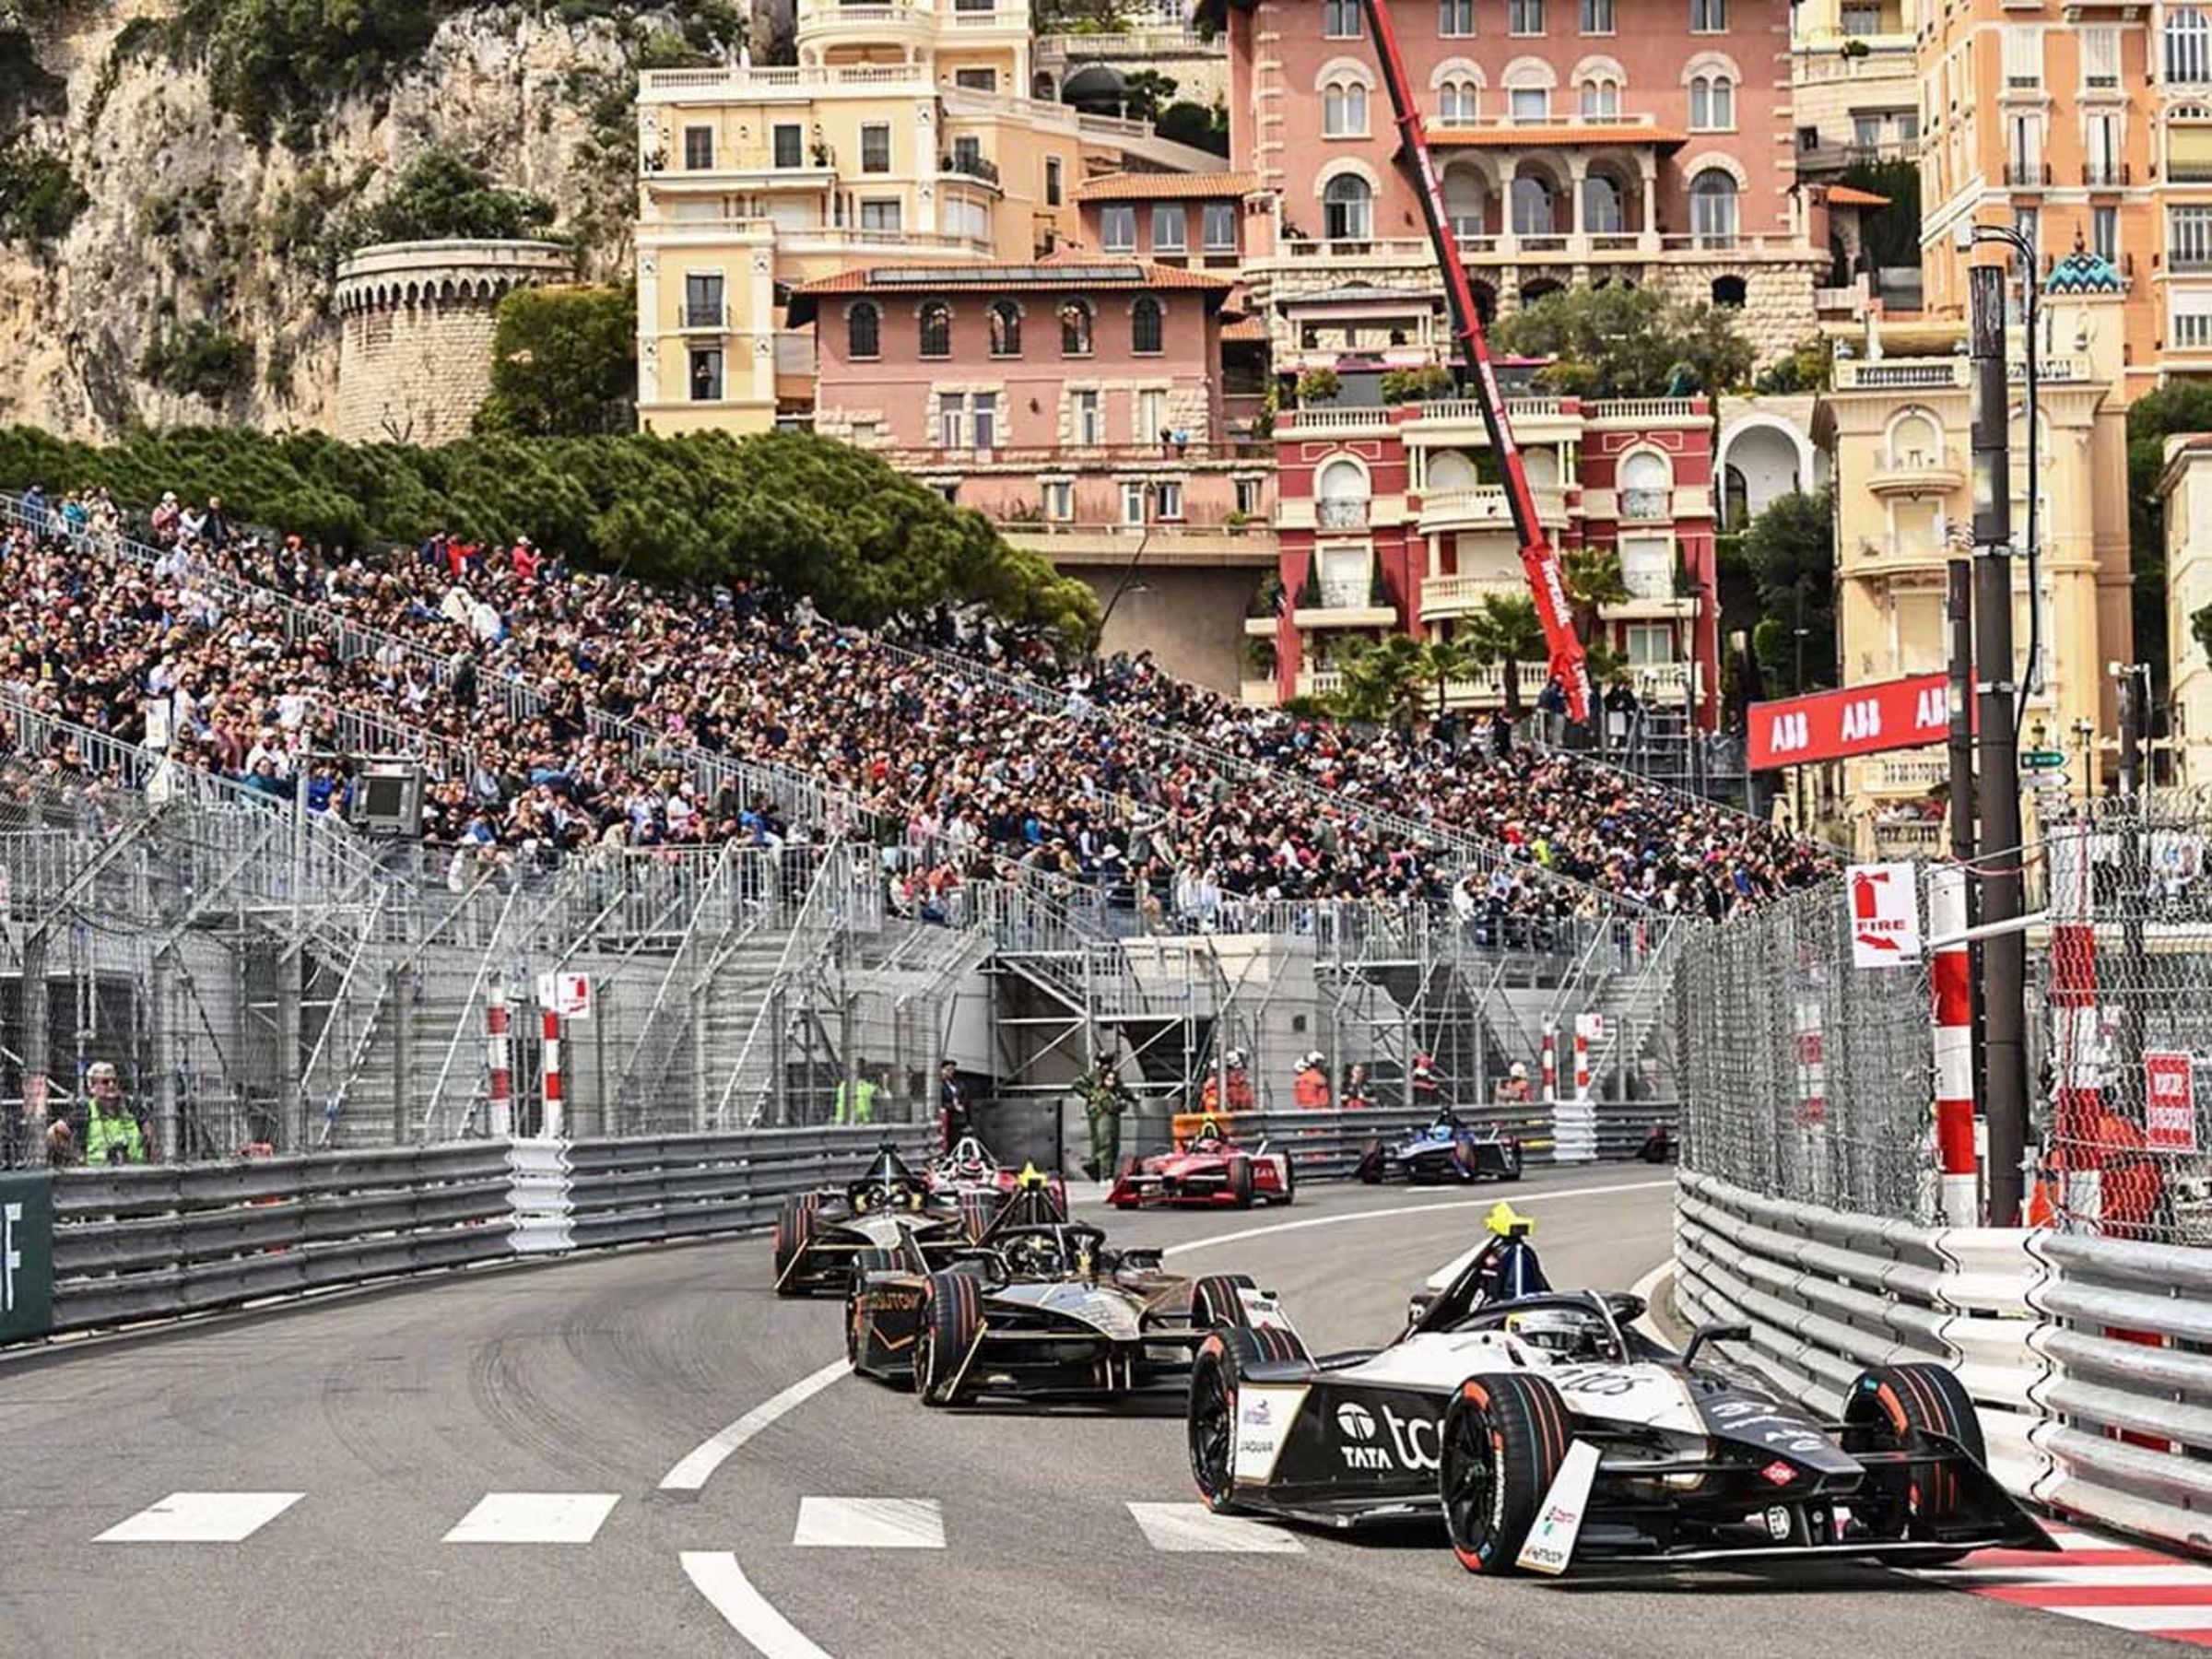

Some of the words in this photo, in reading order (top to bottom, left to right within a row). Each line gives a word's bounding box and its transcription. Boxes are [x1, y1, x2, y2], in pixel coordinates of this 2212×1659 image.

[1841, 699, 1881, 742] ABB
[1915, 687, 1949, 729] AB
[1771, 712, 1808, 753] ABB
[1857, 919, 1906, 932] FIRE
[0, 1202, 23, 1312] F
[1340, 1445, 1394, 1470] TATA
[1381, 1404, 1445, 1471] tc
